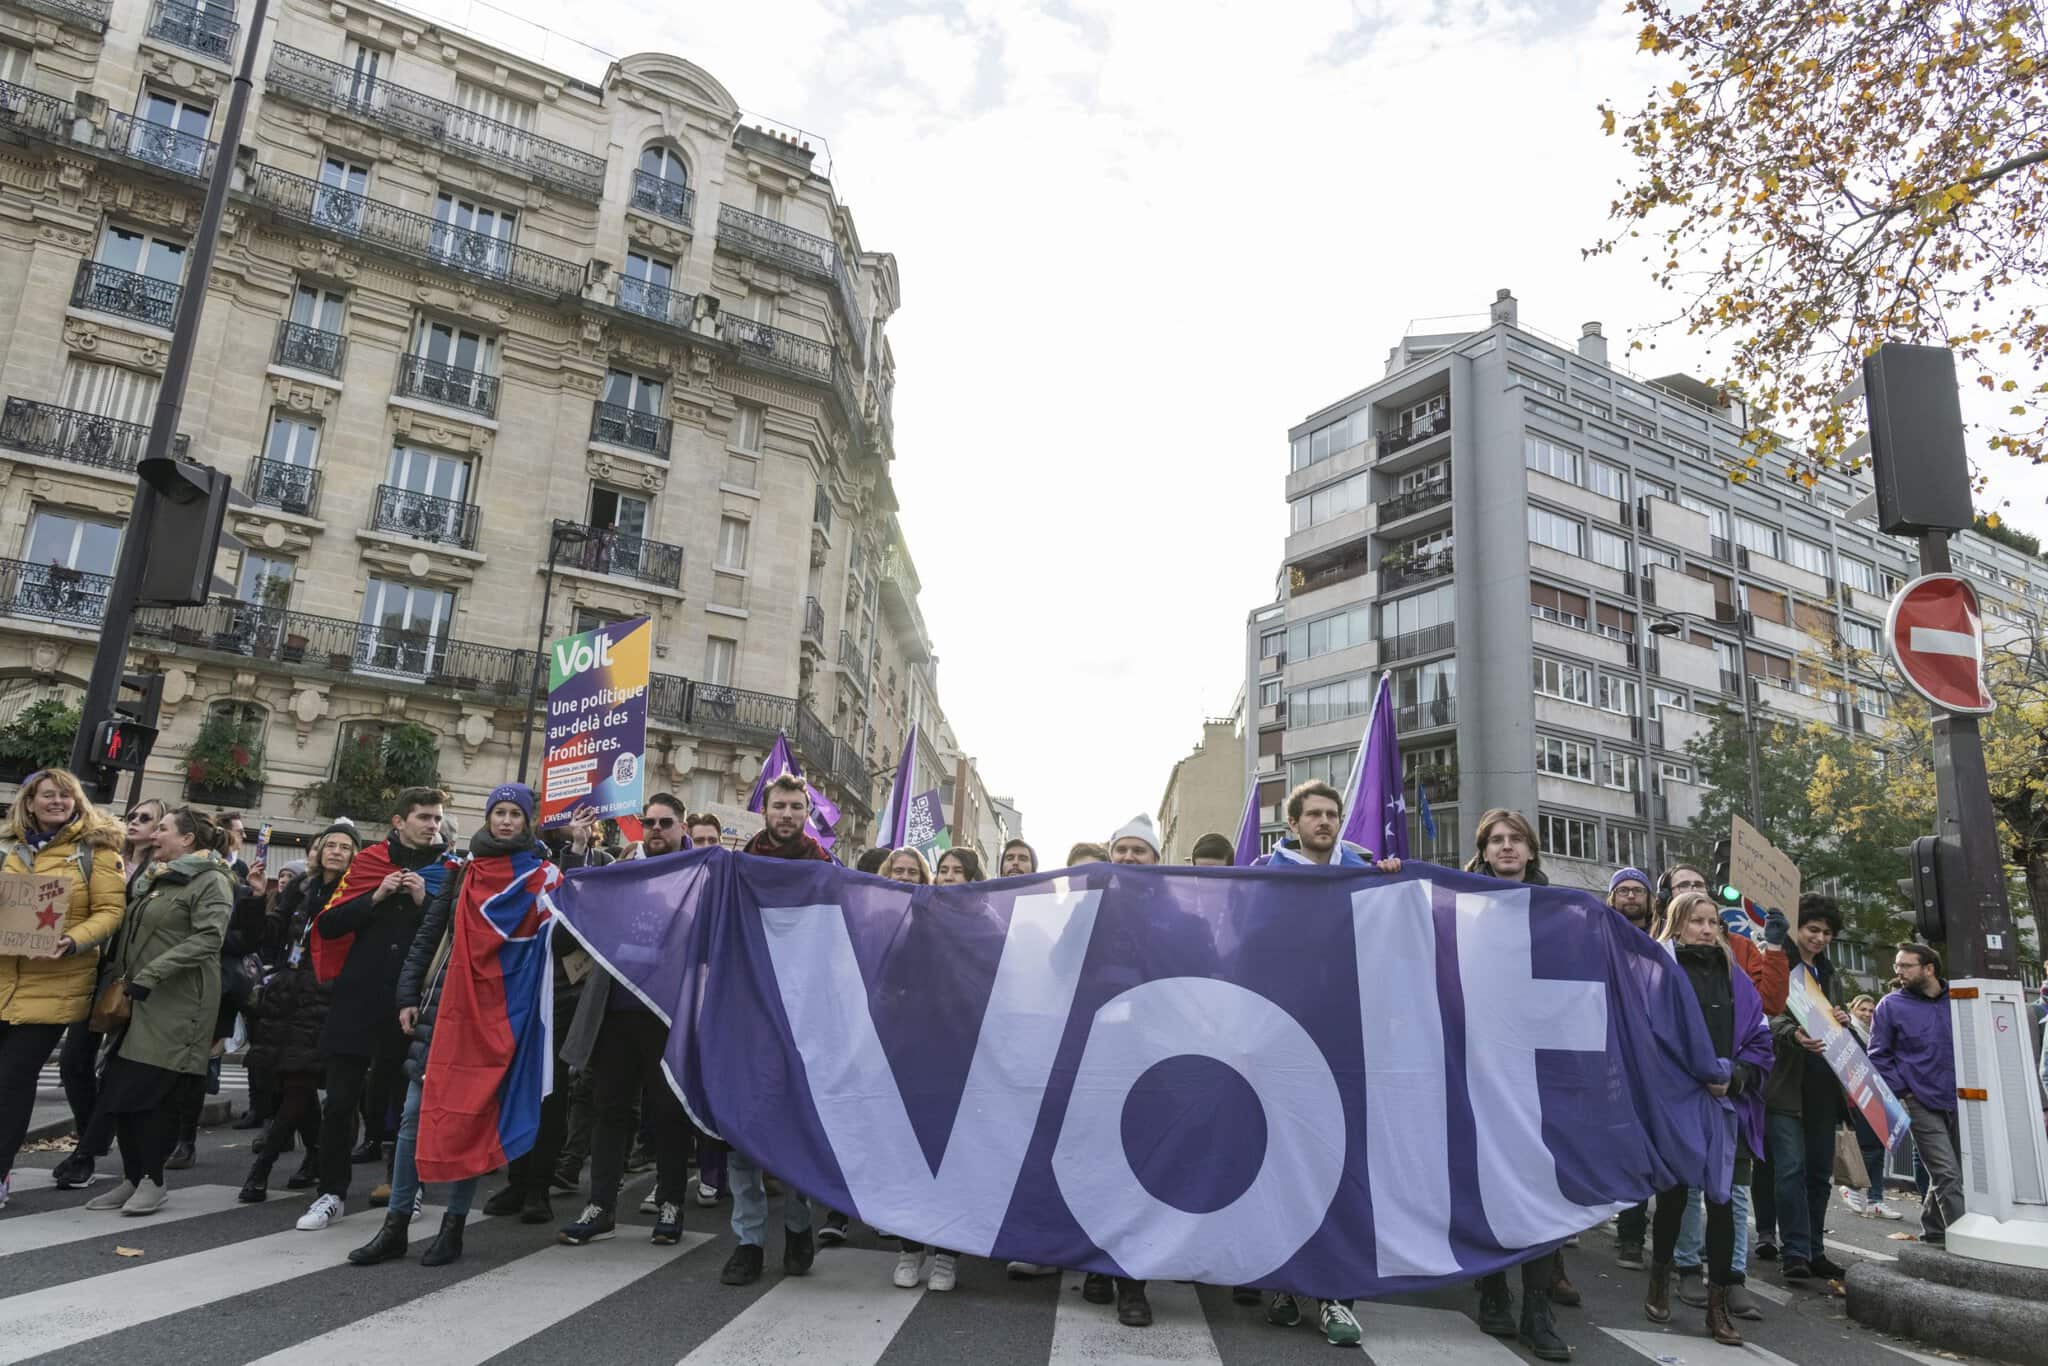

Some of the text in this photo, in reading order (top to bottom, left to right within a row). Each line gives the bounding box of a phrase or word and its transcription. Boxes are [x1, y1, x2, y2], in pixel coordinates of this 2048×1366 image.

[556, 632, 615, 677] Volt
[552, 685, 644, 716] Une politique
[550, 710, 628, 739] au-delà des
[549, 737, 621, 762] frontières.
[40, 880, 60, 892] THE
[761, 879, 1640, 1286] Volt
